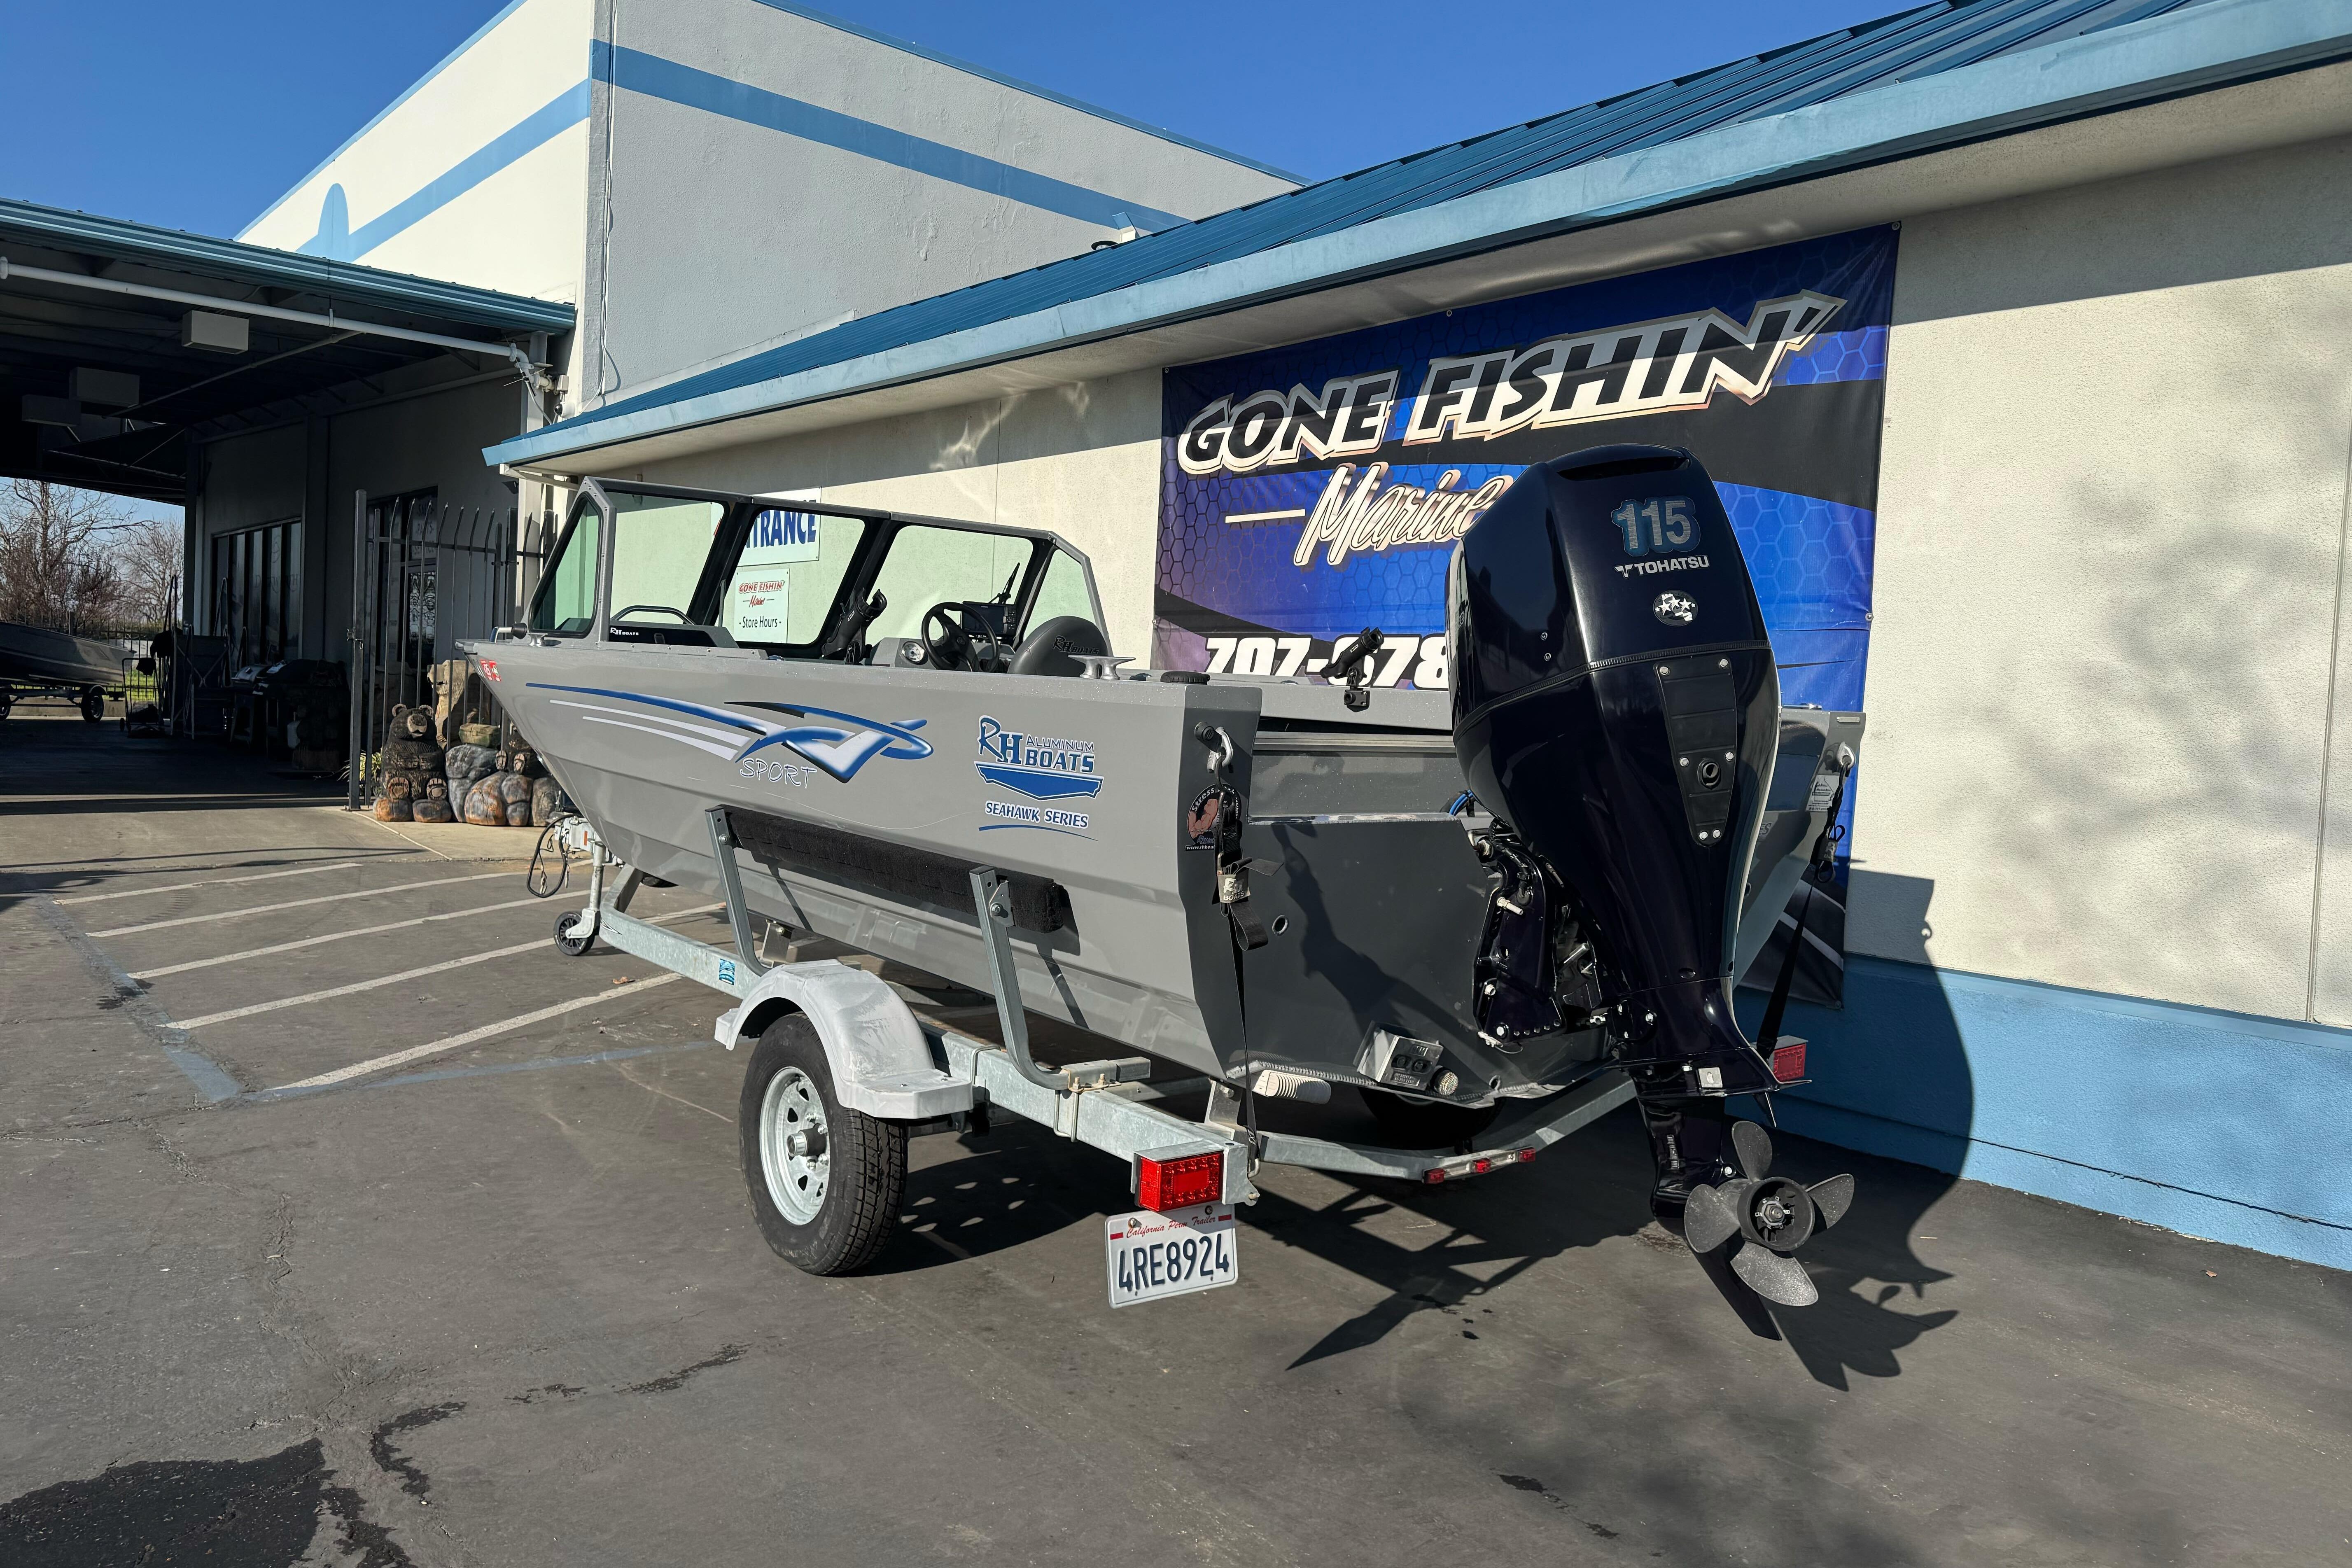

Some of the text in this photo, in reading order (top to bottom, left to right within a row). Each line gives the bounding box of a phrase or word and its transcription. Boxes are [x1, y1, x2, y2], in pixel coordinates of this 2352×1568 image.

[1180, 294, 1841, 471] GONE FISHIN'
[1294, 462, 1511, 565] Marine
[1616, 499, 1693, 550] 115
[1634, 556, 1709, 575] TOHATSU
[739, 583, 758, 593] GONE
[742, 616, 777, 628] Store Hours
[978, 716, 1023, 765] RH
[1025, 735, 1094, 753] ALUMINUM
[1024, 747, 1095, 773] BOATS
[740, 758, 817, 789] SPORT
[1191, 787, 1215, 812] Stress
[985, 801, 1089, 829] SEAHAWK SERIES
[1223, 891, 1244, 901] BOATS
[1126, 1216, 1216, 1238] California Perm Trailer
[1118, 1234, 1230, 1292] 4RE8924
